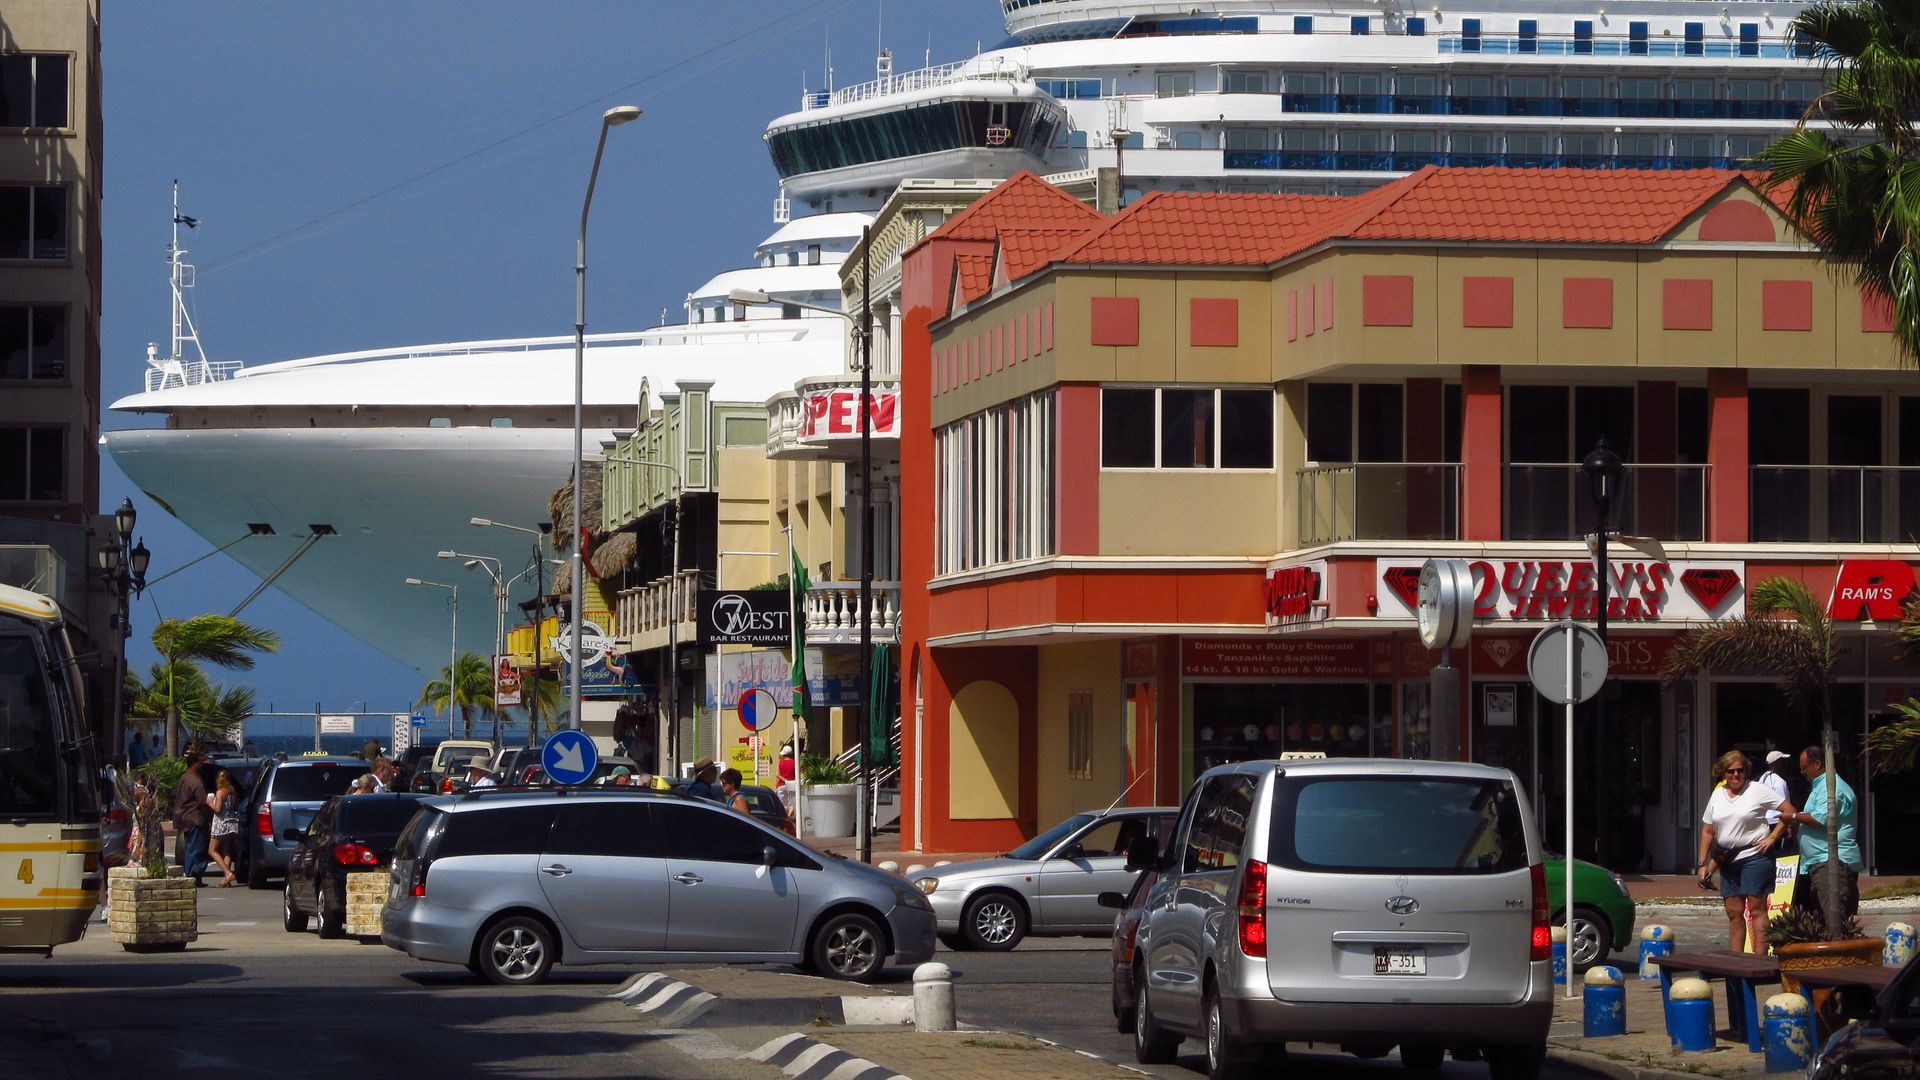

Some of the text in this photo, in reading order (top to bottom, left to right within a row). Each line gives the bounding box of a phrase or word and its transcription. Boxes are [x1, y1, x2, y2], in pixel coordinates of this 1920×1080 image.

[800, 392, 896, 437] PEN
[1841, 587, 1893, 600] RAM'S
[719, 599, 789, 634] 7 WEST
[1195, 642, 1354, 652] Diamonds Ruby Emerald
[1217, 654, 1336, 664] Tanzanite Sapphire
[1185, 665, 1364, 674] 14 kt. & 18 kt. Gold & Watches
[17, 859, 34, 884] 4
